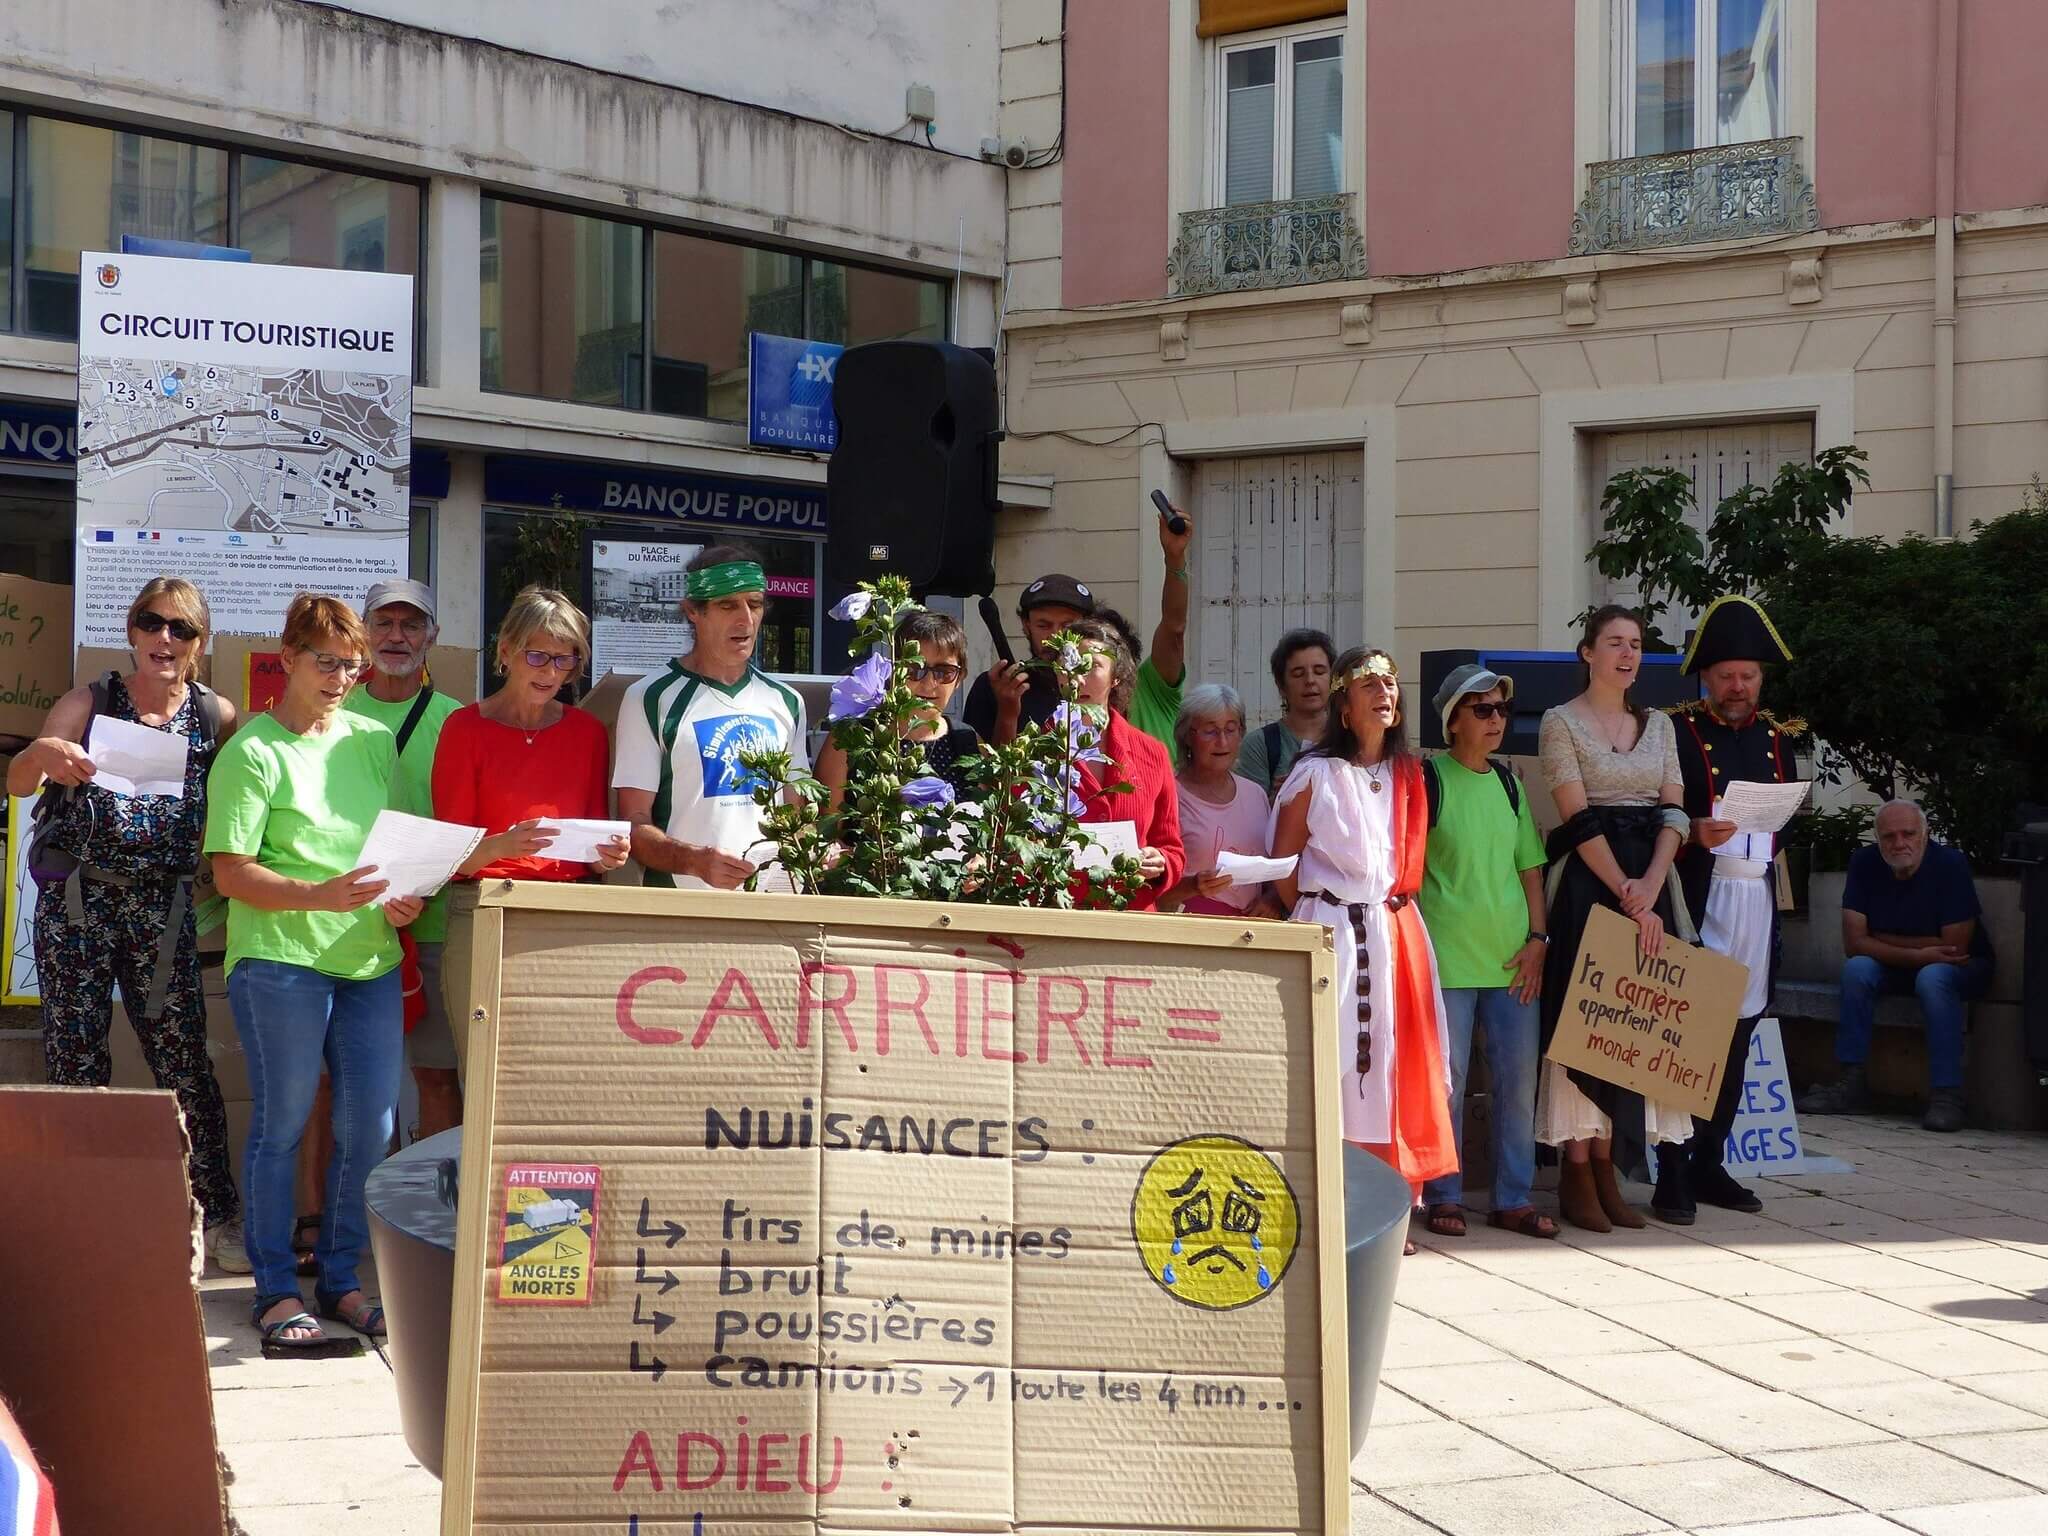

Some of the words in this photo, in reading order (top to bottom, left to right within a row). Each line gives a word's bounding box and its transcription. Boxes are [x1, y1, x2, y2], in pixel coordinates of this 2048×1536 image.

[100, 312, 214, 341] CIRCUIT
[221, 320, 395, 353] TOURISTIQUE
[207, 367, 216, 379] 6
[108, 381, 113, 394] 1
[117, 383, 126, 394] 2
[144, 379, 154, 391] 4
[128, 389, 136, 401] 3
[185, 397, 194, 409] 5
[270, 408, 279, 421] 8
[760, 411, 835, 430] BANQUE
[216, 416, 225, 428] 7
[311, 430, 321, 442] 9
[760, 426, 835, 445] POPULAIRE
[358, 454, 376, 467] 10
[604, 481, 730, 518] BANQUE
[736, 495, 826, 527] POPUL
[335, 509, 350, 522] 11
[120, 548, 130, 556] de
[241, 552, 272, 561] industrie
[274, 554, 297, 562] textile
[641, 546, 669, 555] PLACE
[628, 553, 641, 562] DU
[643, 554, 681, 563] MARCHÉ
[269, 563, 327, 572] communication
[328, 564, 336, 572] et
[374, 566, 398, 574] douce
[294, 582, 308, 590] des
[309, 583, 354, 591] mousselines
[85, 602, 102, 610] Lieu
[85, 624, 106, 632] Nous
[107, 625, 126, 633] vous
[1635, 933, 1685, 988] Vinci
[1579, 953, 1604, 993] ta
[1615, 976, 1690, 1024] carrière
[1579, 999, 1658, 1034] appartient
[1662, 1028, 1682, 1048] au
[1587, 1033, 1641, 1068] monde
[509, 1170, 596, 1185] ATTENTION
[723, 1198, 803, 1244] tirs
[931, 1215, 1073, 1260] mines
[509, 1264, 581, 1280] ANGLES
[719, 1249, 853, 1297] bruit
[511, 1280, 576, 1296] MORTS
[705, 1352, 923, 1396] camions
[1011, 1373, 1086, 1402] toute
[1099, 1371, 1142, 1402] les
[1157, 1372, 1177, 1414] 4
